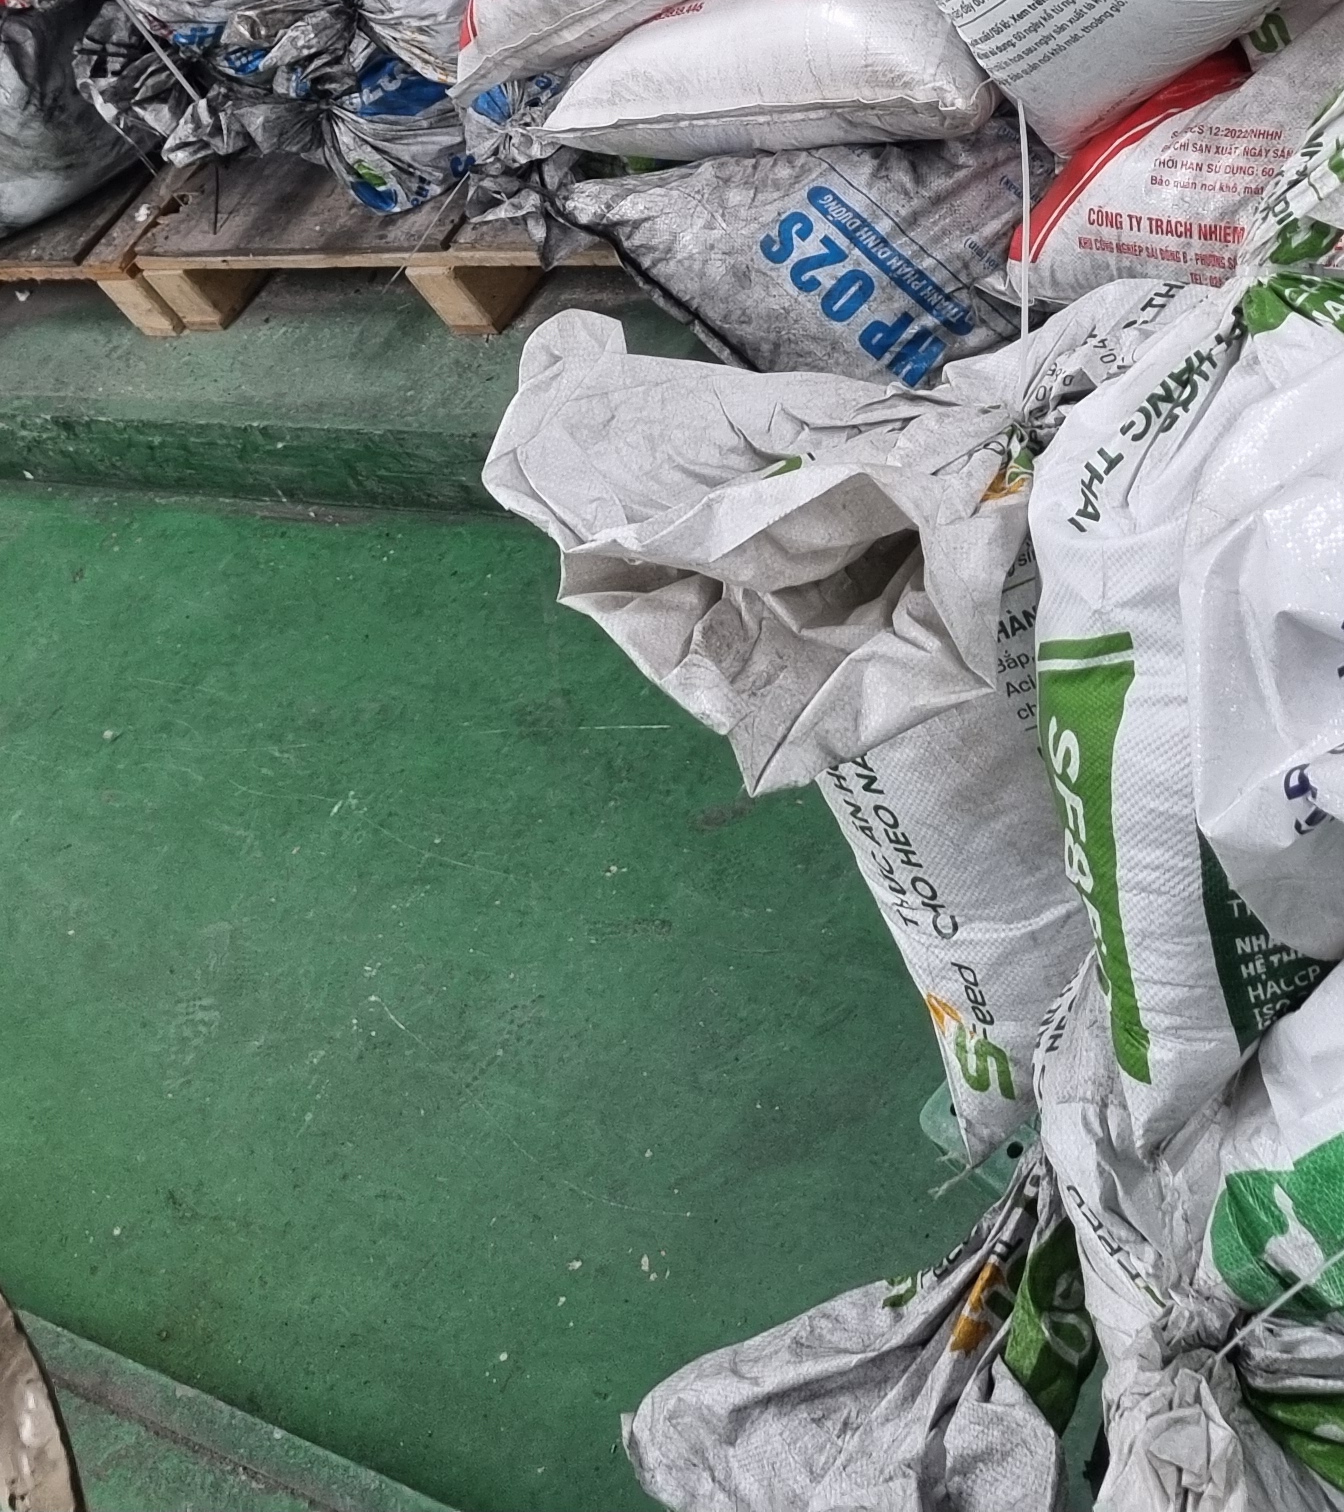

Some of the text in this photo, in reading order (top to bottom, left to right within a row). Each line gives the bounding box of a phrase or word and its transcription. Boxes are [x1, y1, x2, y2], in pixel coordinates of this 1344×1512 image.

[753, 201, 881, 332] 02S
[1086, 207, 1124, 231] CÔNG
[1125, 214, 1143, 233] TY
[1145, 215, 1193, 240] TRÁCH
[853, 294, 952, 394] HP
[1054, 440, 1133, 537] THAI
[869, 798, 923, 876] HEO
